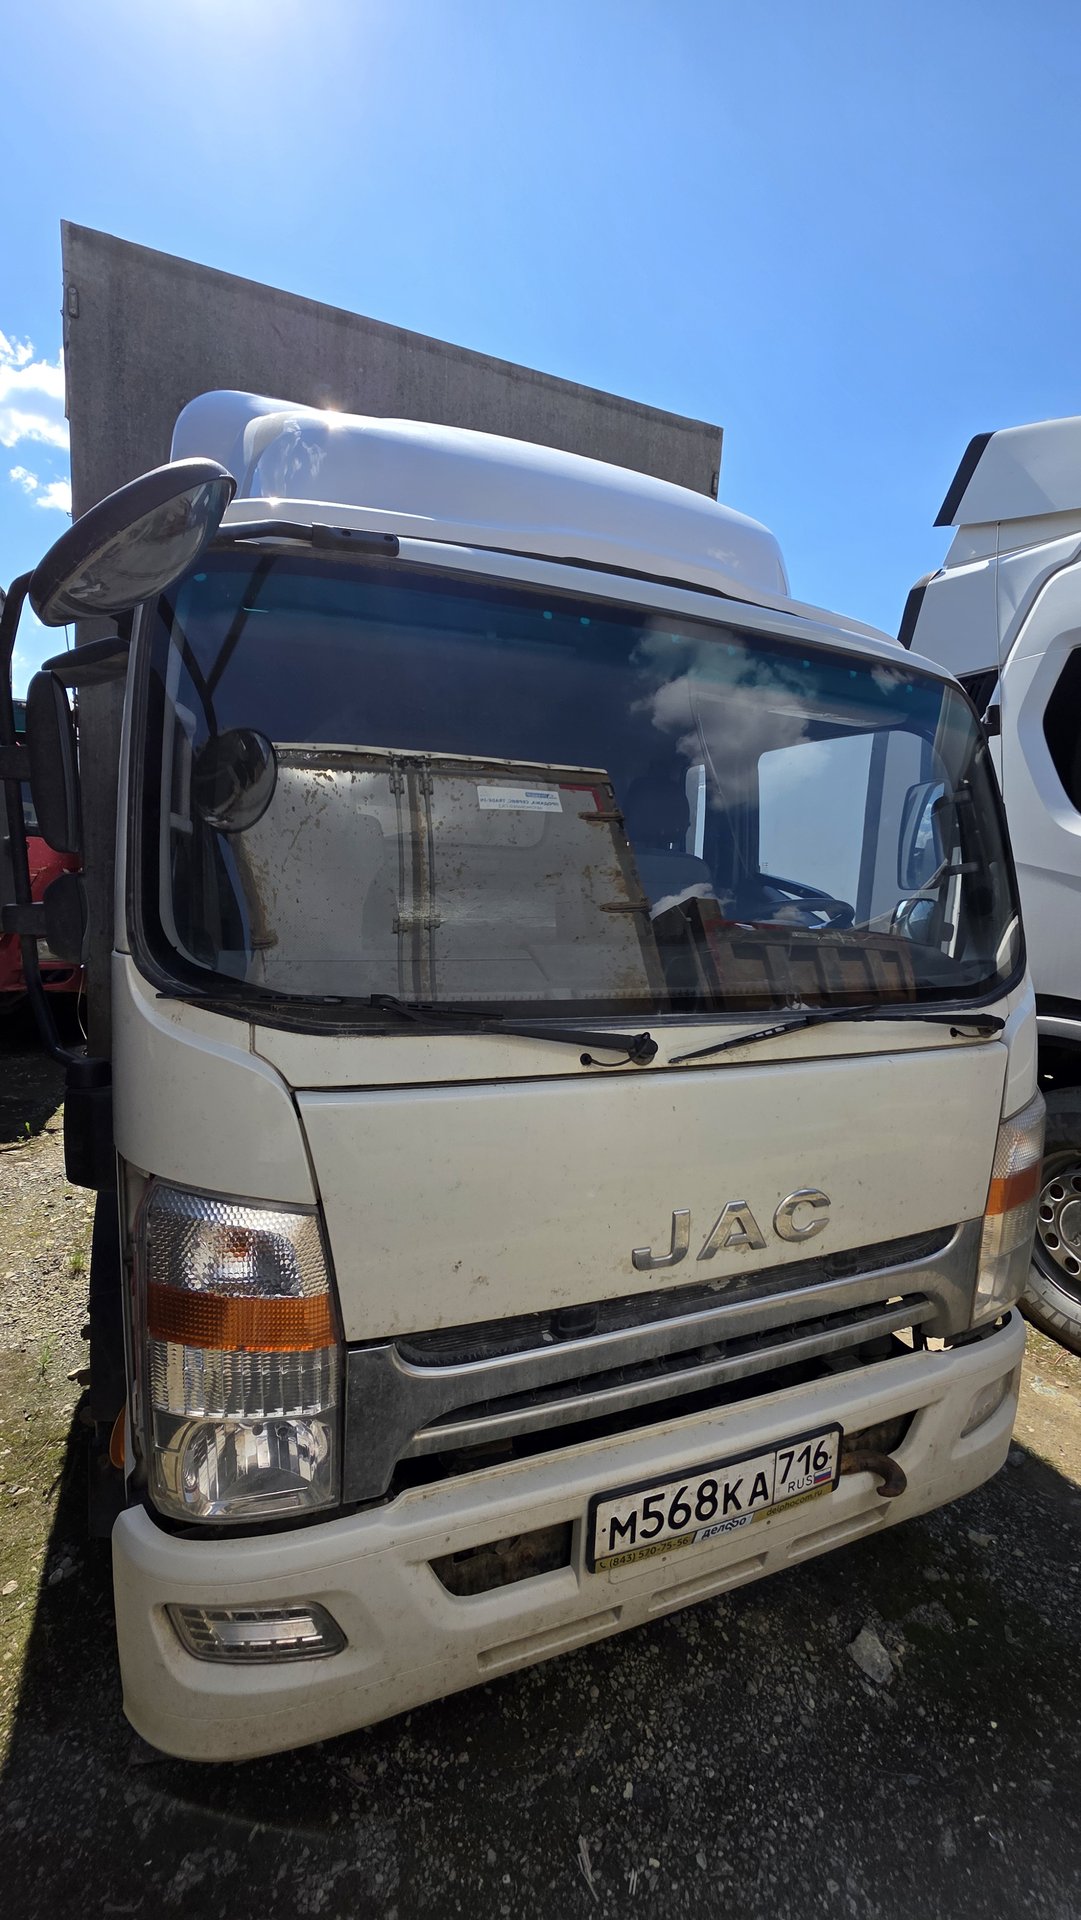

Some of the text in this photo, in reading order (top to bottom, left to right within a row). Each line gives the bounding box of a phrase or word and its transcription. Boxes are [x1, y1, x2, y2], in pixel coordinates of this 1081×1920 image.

[631, 1187, 831, 1271] JAC
[779, 1440, 829, 1484] 716
[787, 1474, 814, 1493] RUS
[766, 1489, 823, 1516] delphocom.ru
[609, 1536, 689, 1569] (843) 570-75-56
